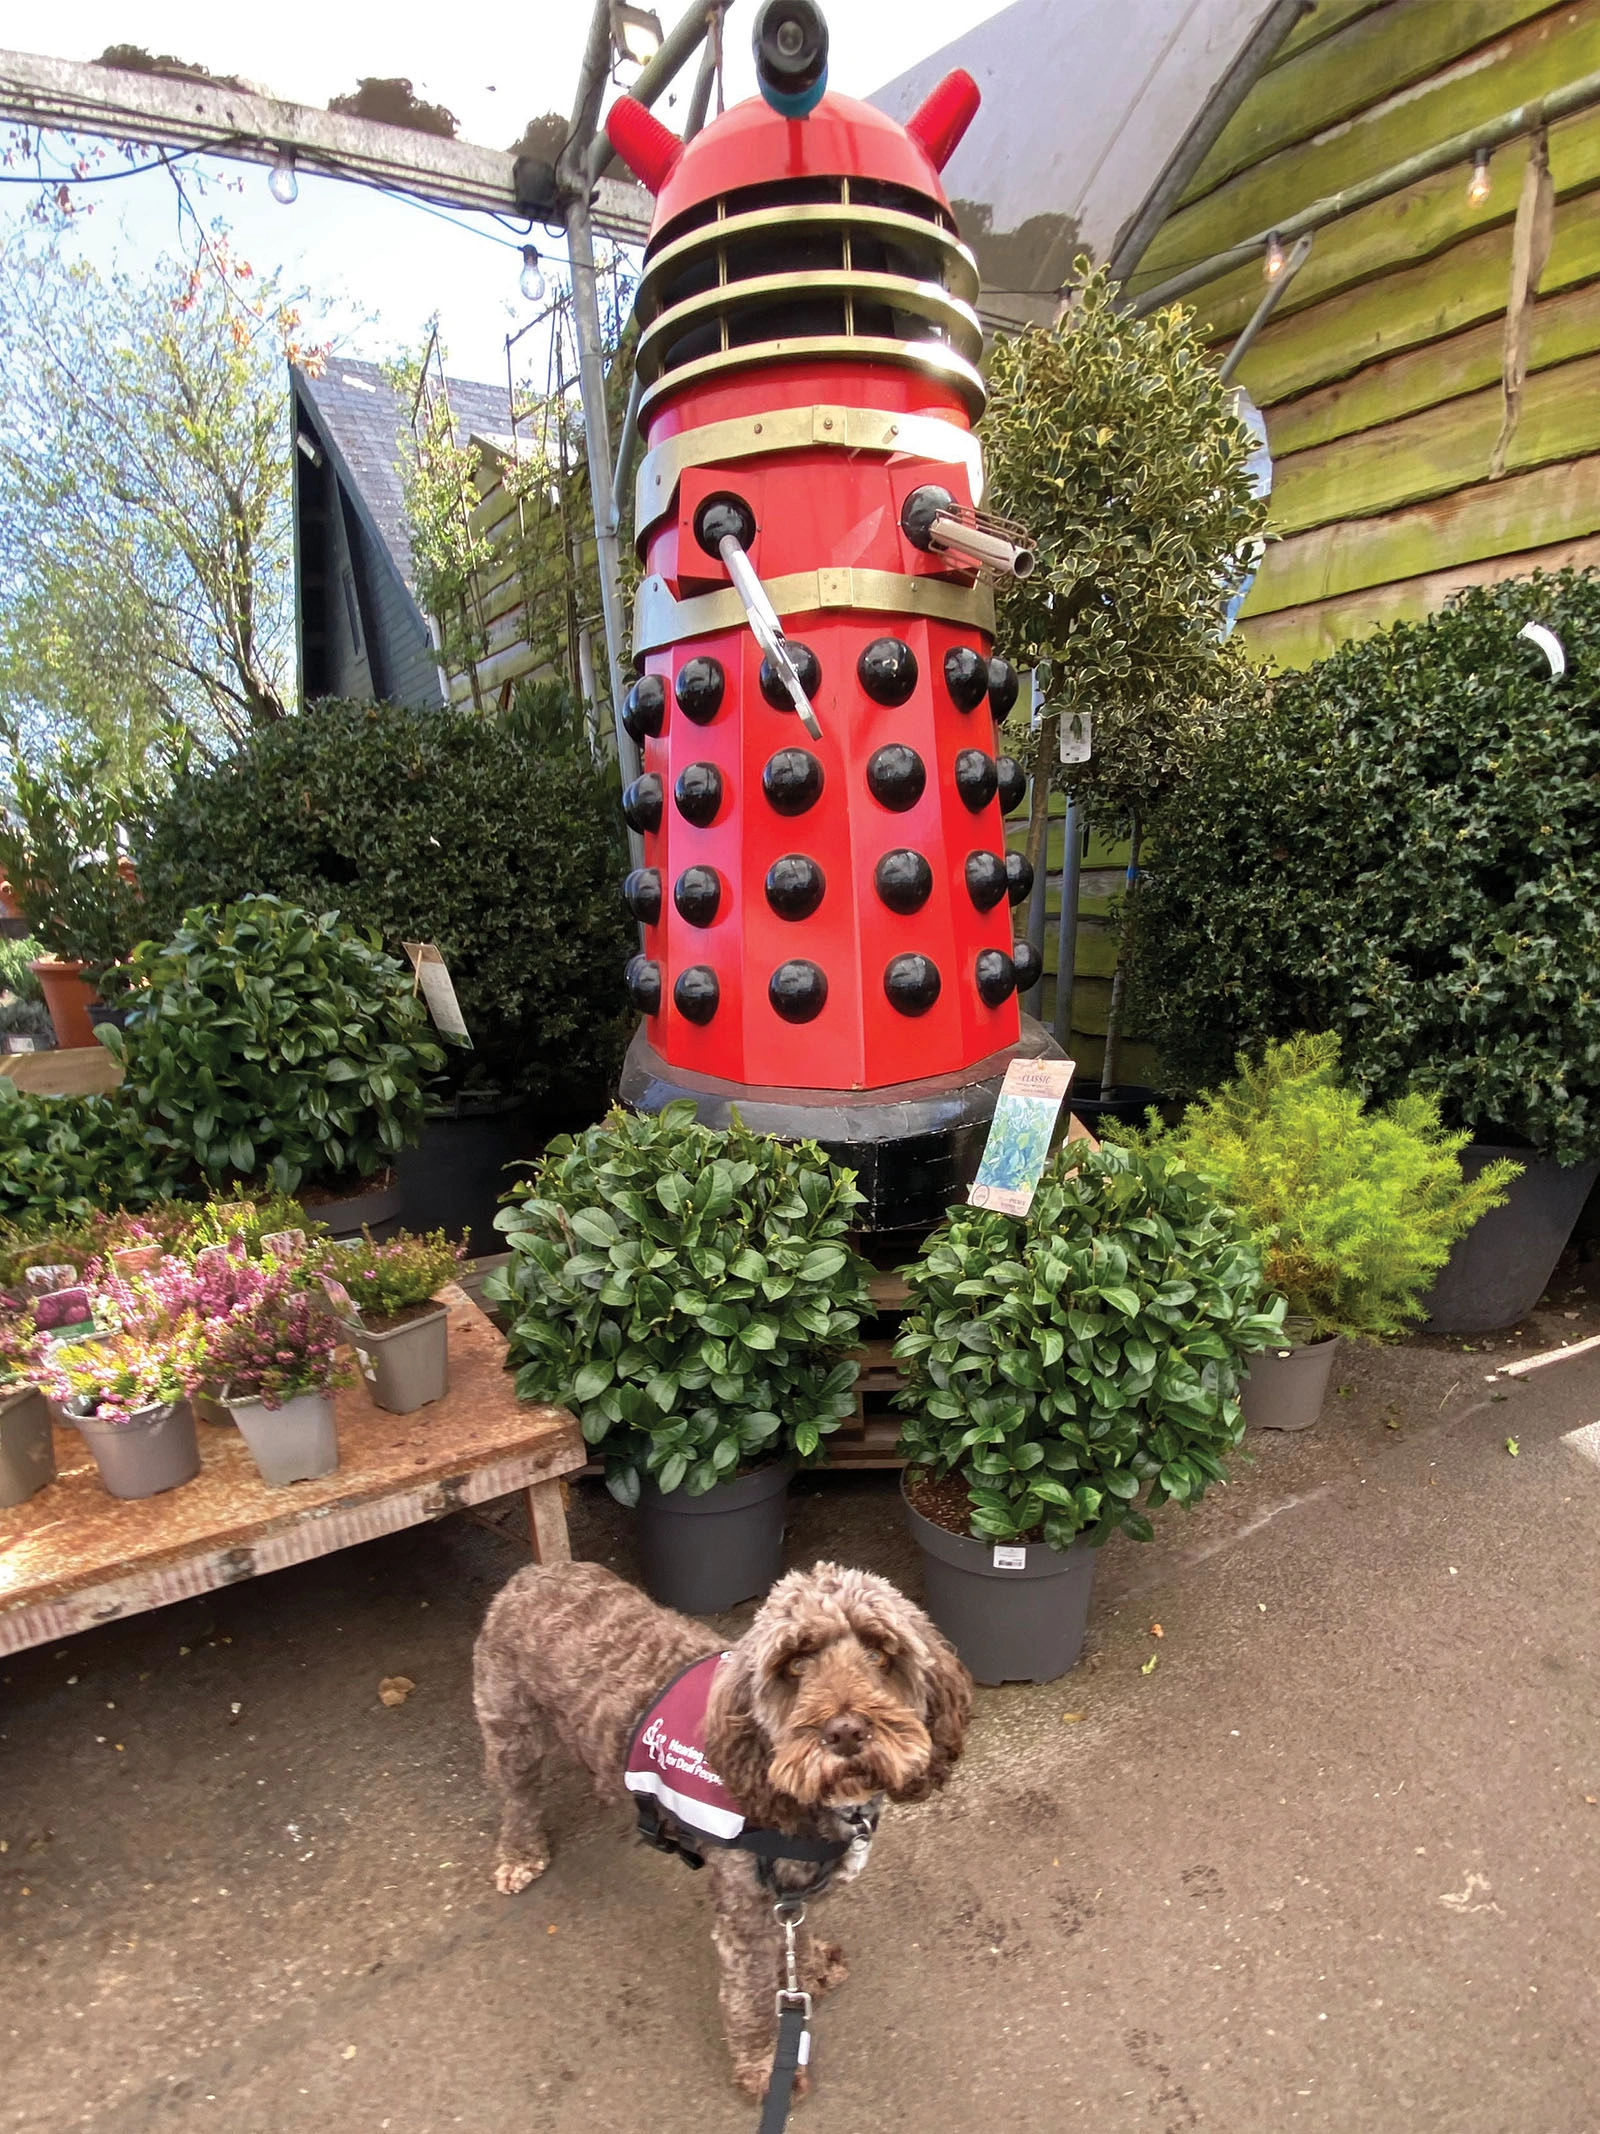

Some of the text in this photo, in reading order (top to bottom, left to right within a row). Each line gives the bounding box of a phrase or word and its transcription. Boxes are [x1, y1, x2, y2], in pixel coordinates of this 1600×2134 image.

[668, 1739, 703, 1764] Hearing
[666, 1753, 677, 1766] for
[675, 1758, 697, 1773] Deaf
